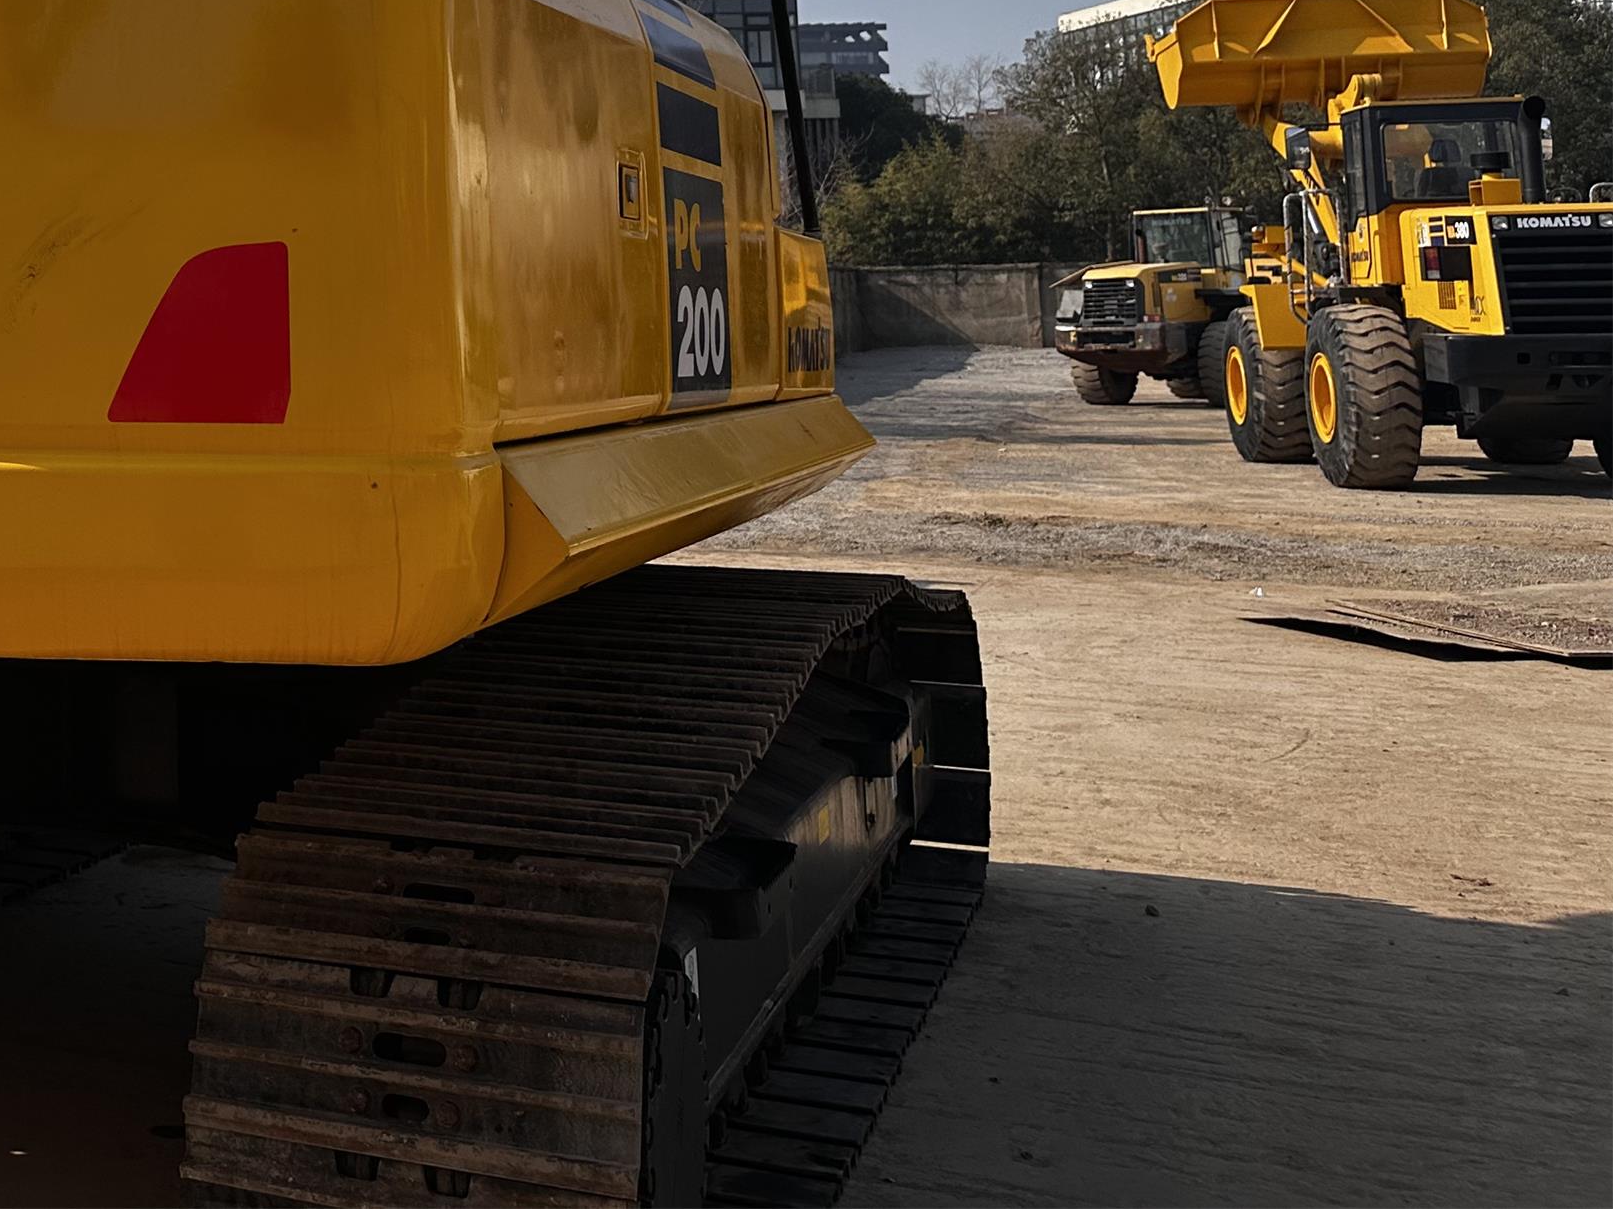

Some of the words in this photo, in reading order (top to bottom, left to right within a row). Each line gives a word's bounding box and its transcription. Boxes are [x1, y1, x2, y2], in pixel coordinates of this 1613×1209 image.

[674, 198, 701, 272] PC
[1516, 214, 1591, 228] KOMATSU
[677, 285, 725, 377] 200
